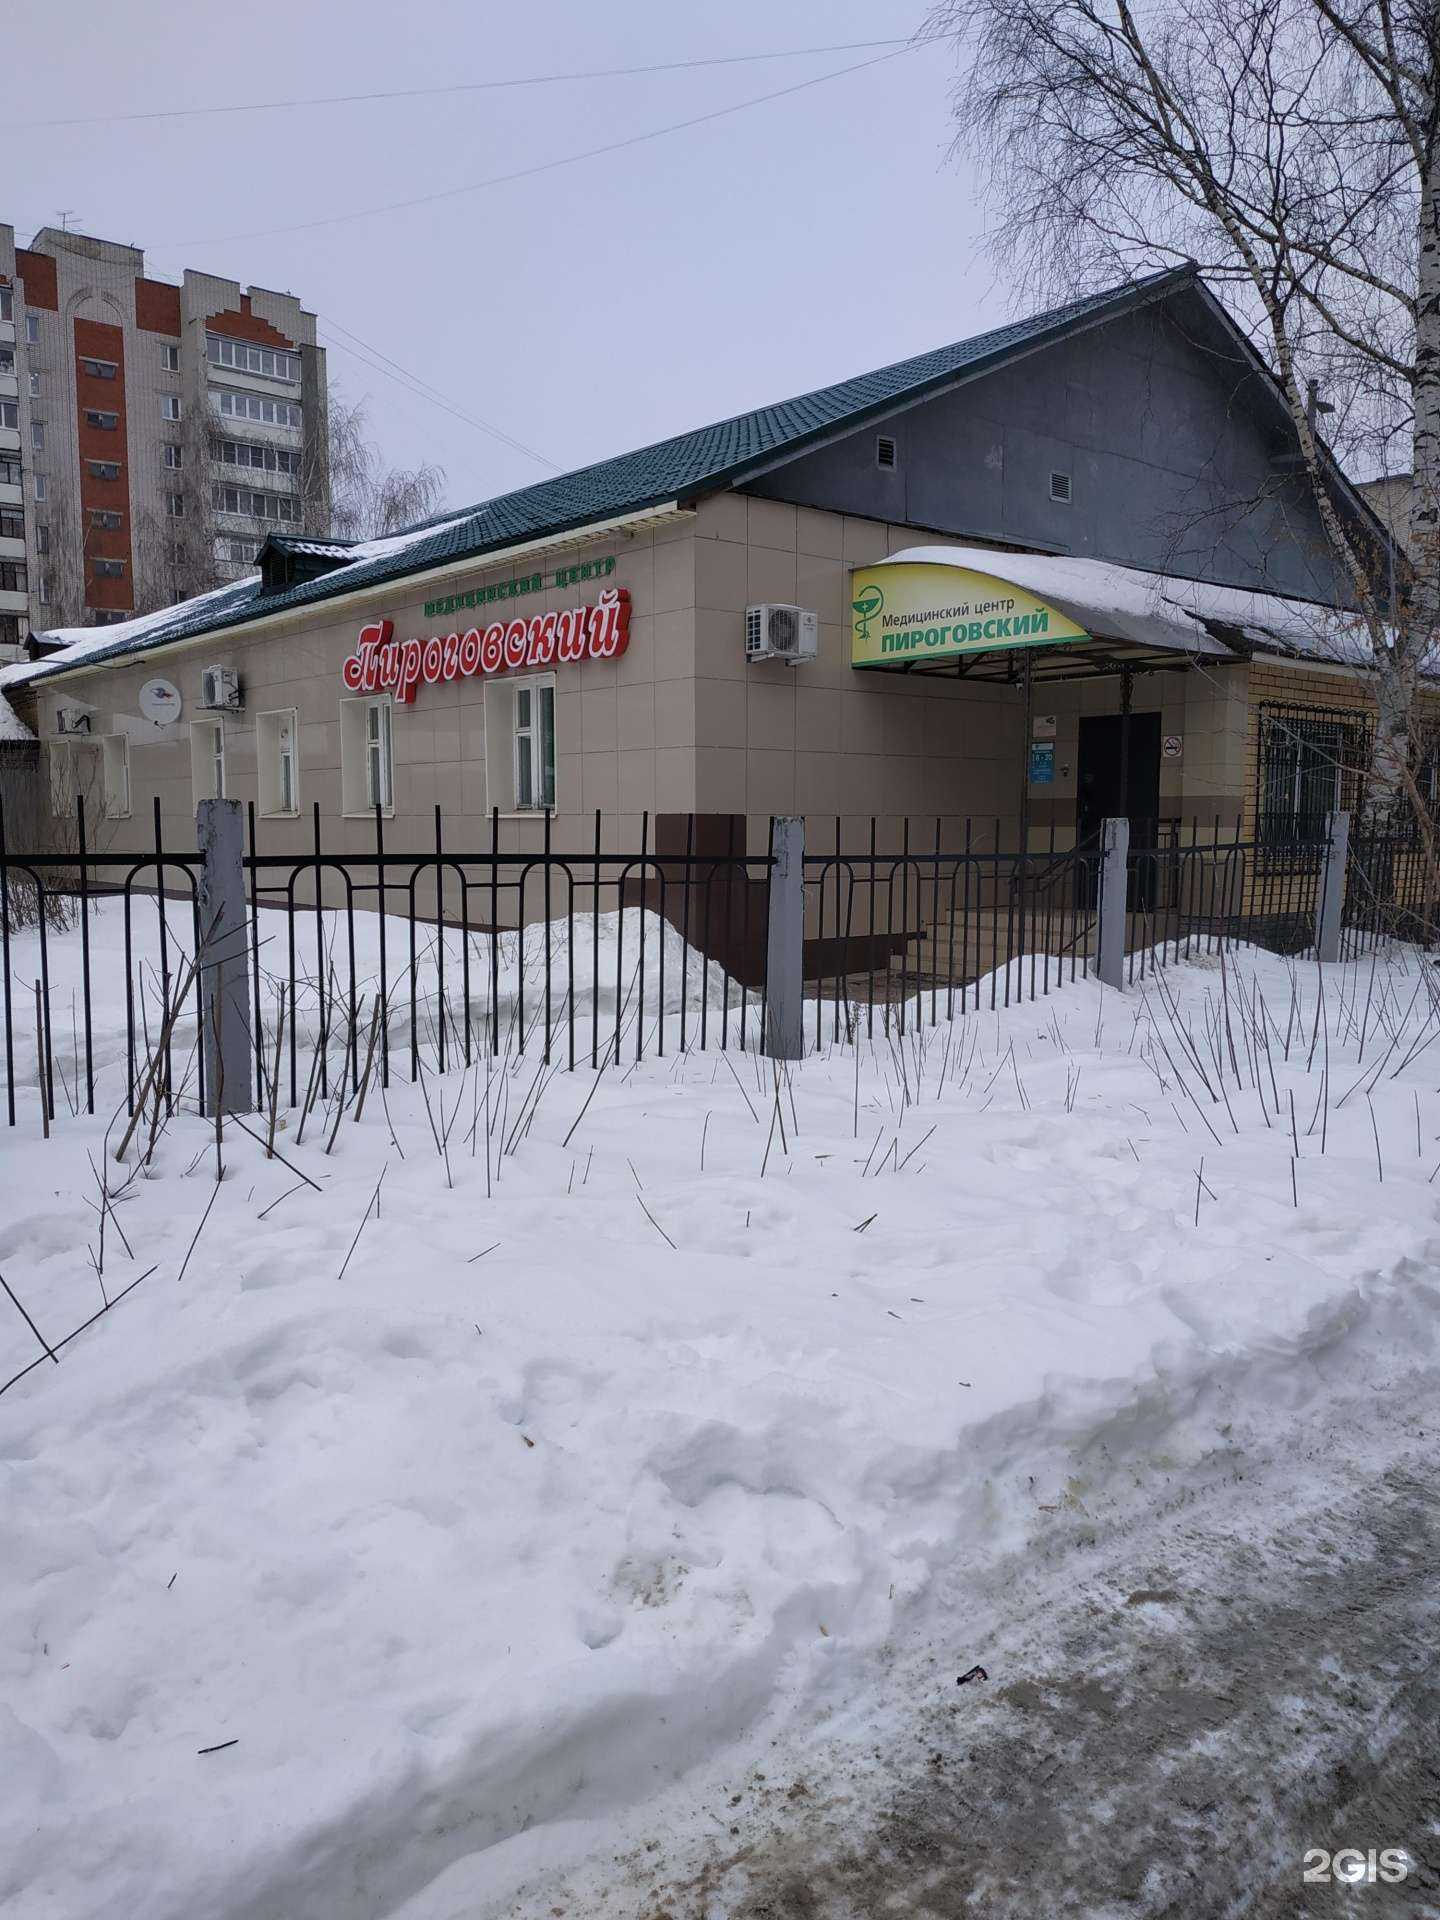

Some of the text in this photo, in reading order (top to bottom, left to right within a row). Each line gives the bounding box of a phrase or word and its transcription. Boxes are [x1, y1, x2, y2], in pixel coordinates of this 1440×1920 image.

[555, 556, 616, 590] ЦЕНТР
[881, 607, 1049, 653] ПИРОГОВСКИЙ
[882, 598, 1015, 628] Медицинский центр
[343, 587, 631, 704] Пироговский
